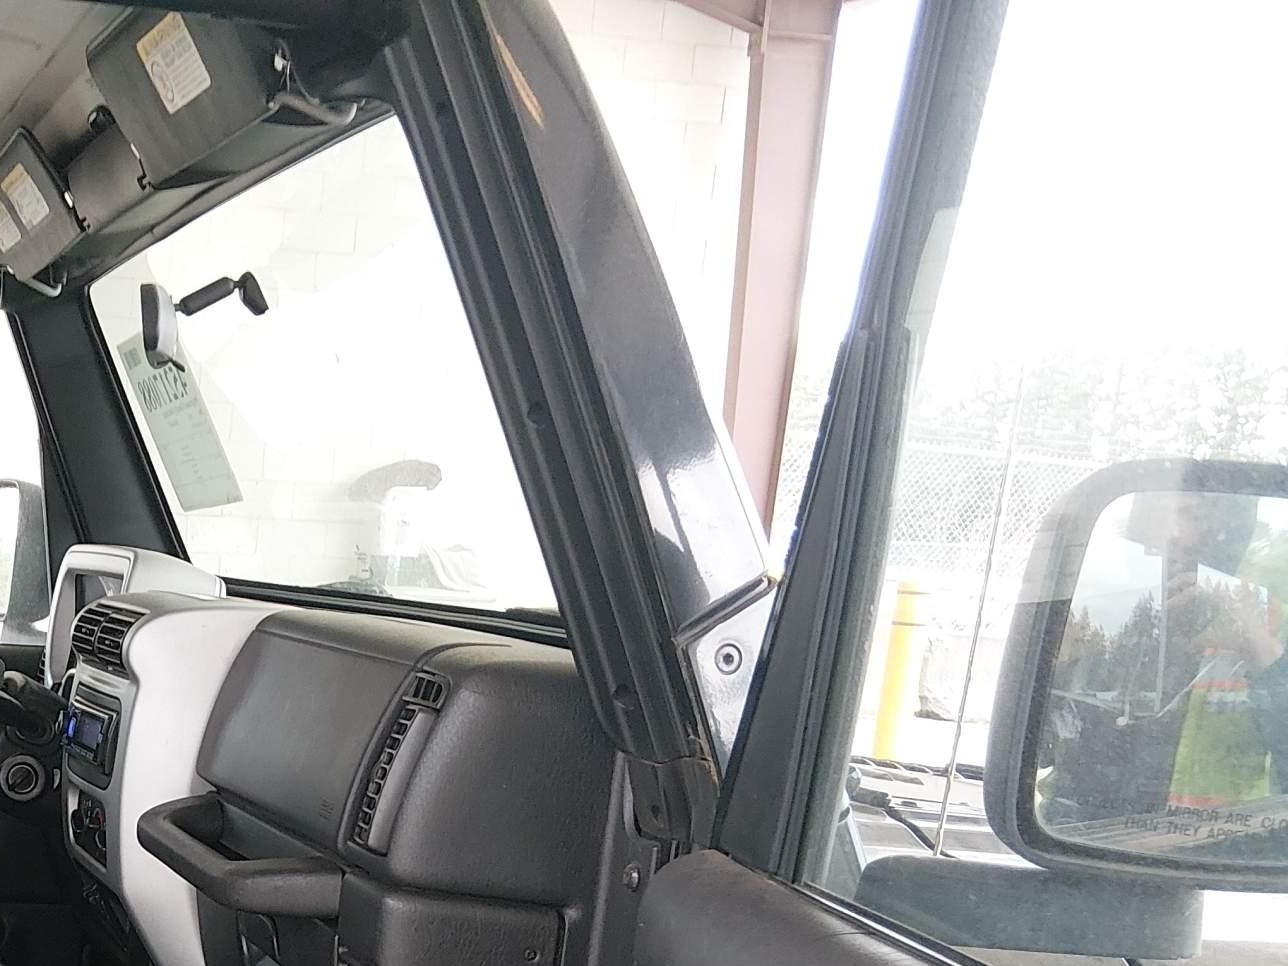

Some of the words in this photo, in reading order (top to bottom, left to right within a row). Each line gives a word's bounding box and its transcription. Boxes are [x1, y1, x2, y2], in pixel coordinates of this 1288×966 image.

[1166, 805, 1219, 823] MIRROR
[1224, 812, 1253, 828] ARE
[1166, 821, 1201, 837] THEY
